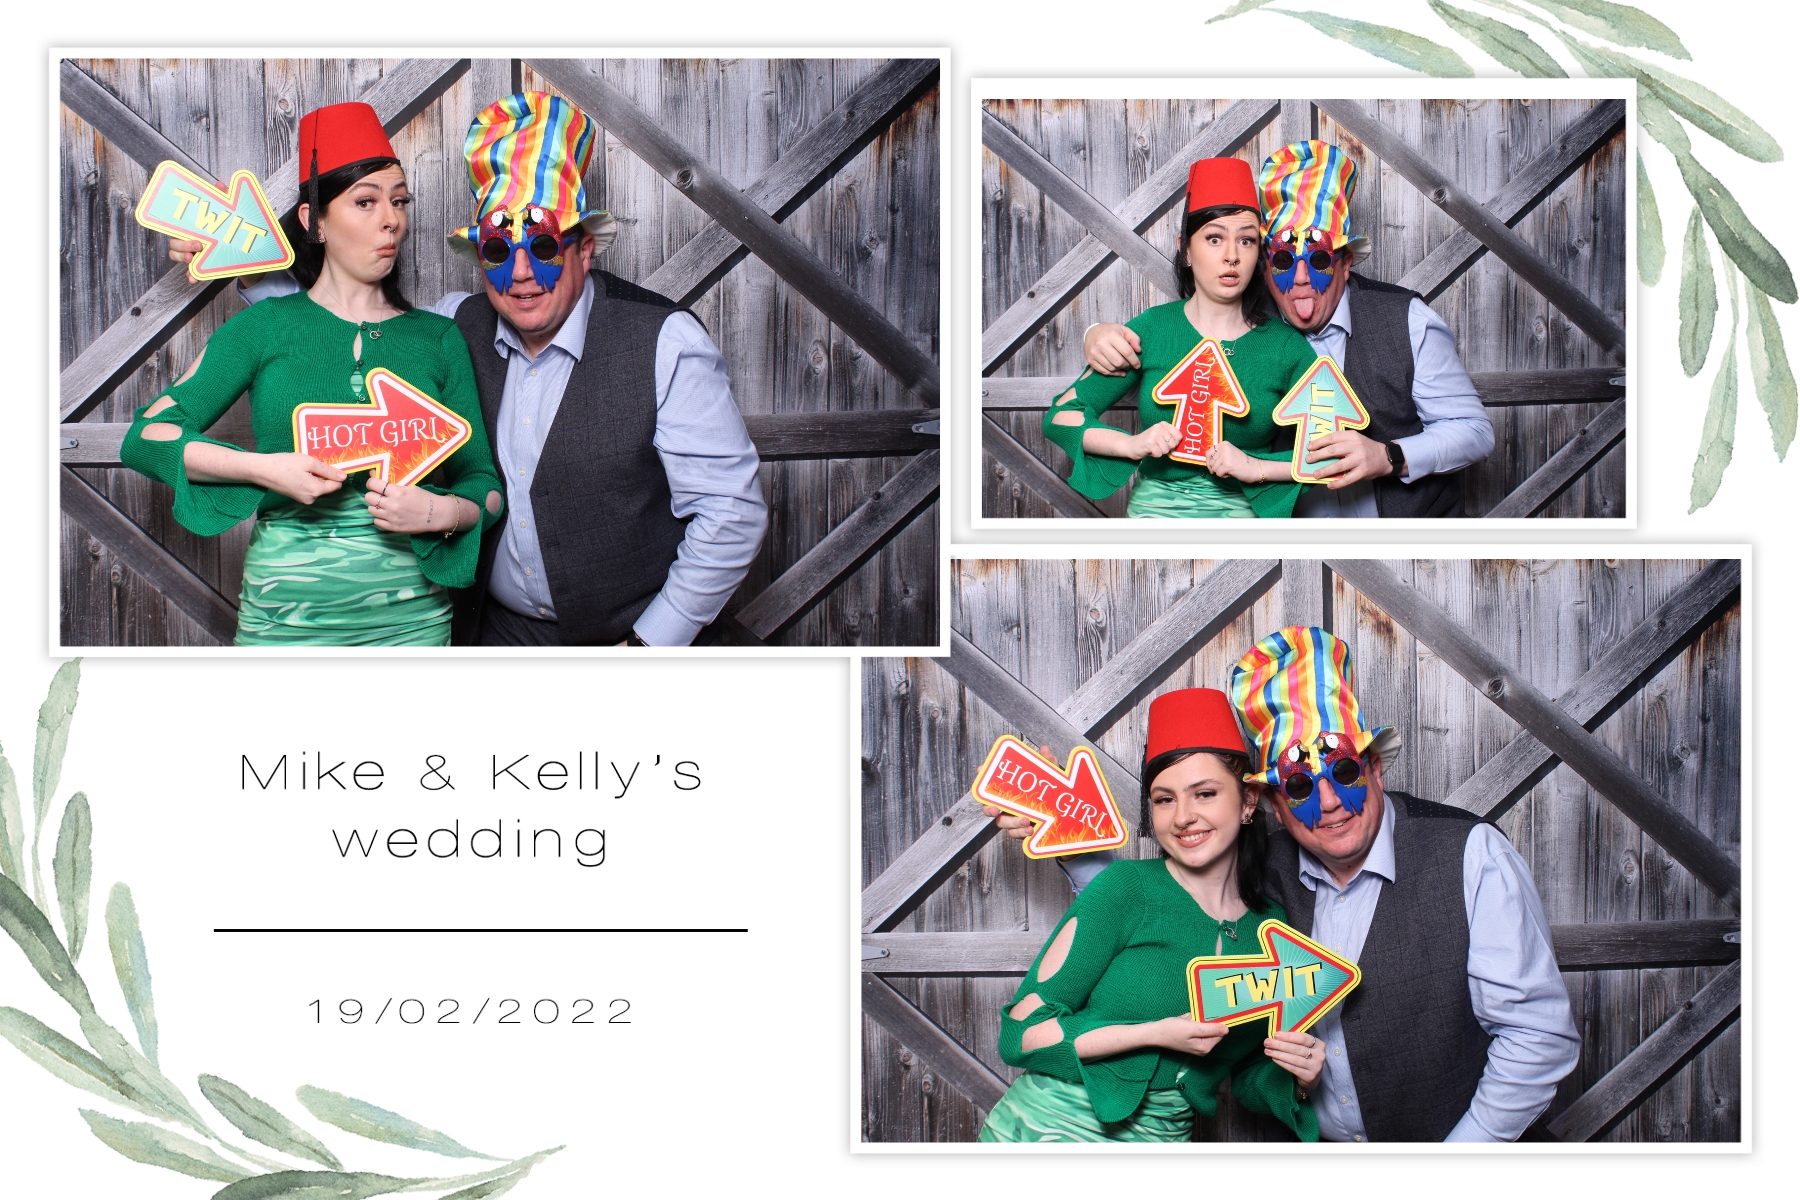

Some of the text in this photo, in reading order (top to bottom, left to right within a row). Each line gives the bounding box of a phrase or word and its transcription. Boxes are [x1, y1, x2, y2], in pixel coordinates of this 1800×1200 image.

[173, 188, 268, 254] TWIT
[308, 417, 446, 450] HOT GIRL
[1184, 357, 1216, 453] HOT GIRL
[1309, 383, 1335, 454] WIT
[996, 758, 1108, 838] HOT GIRL
[1214, 962, 1323, 1008] TWIT
